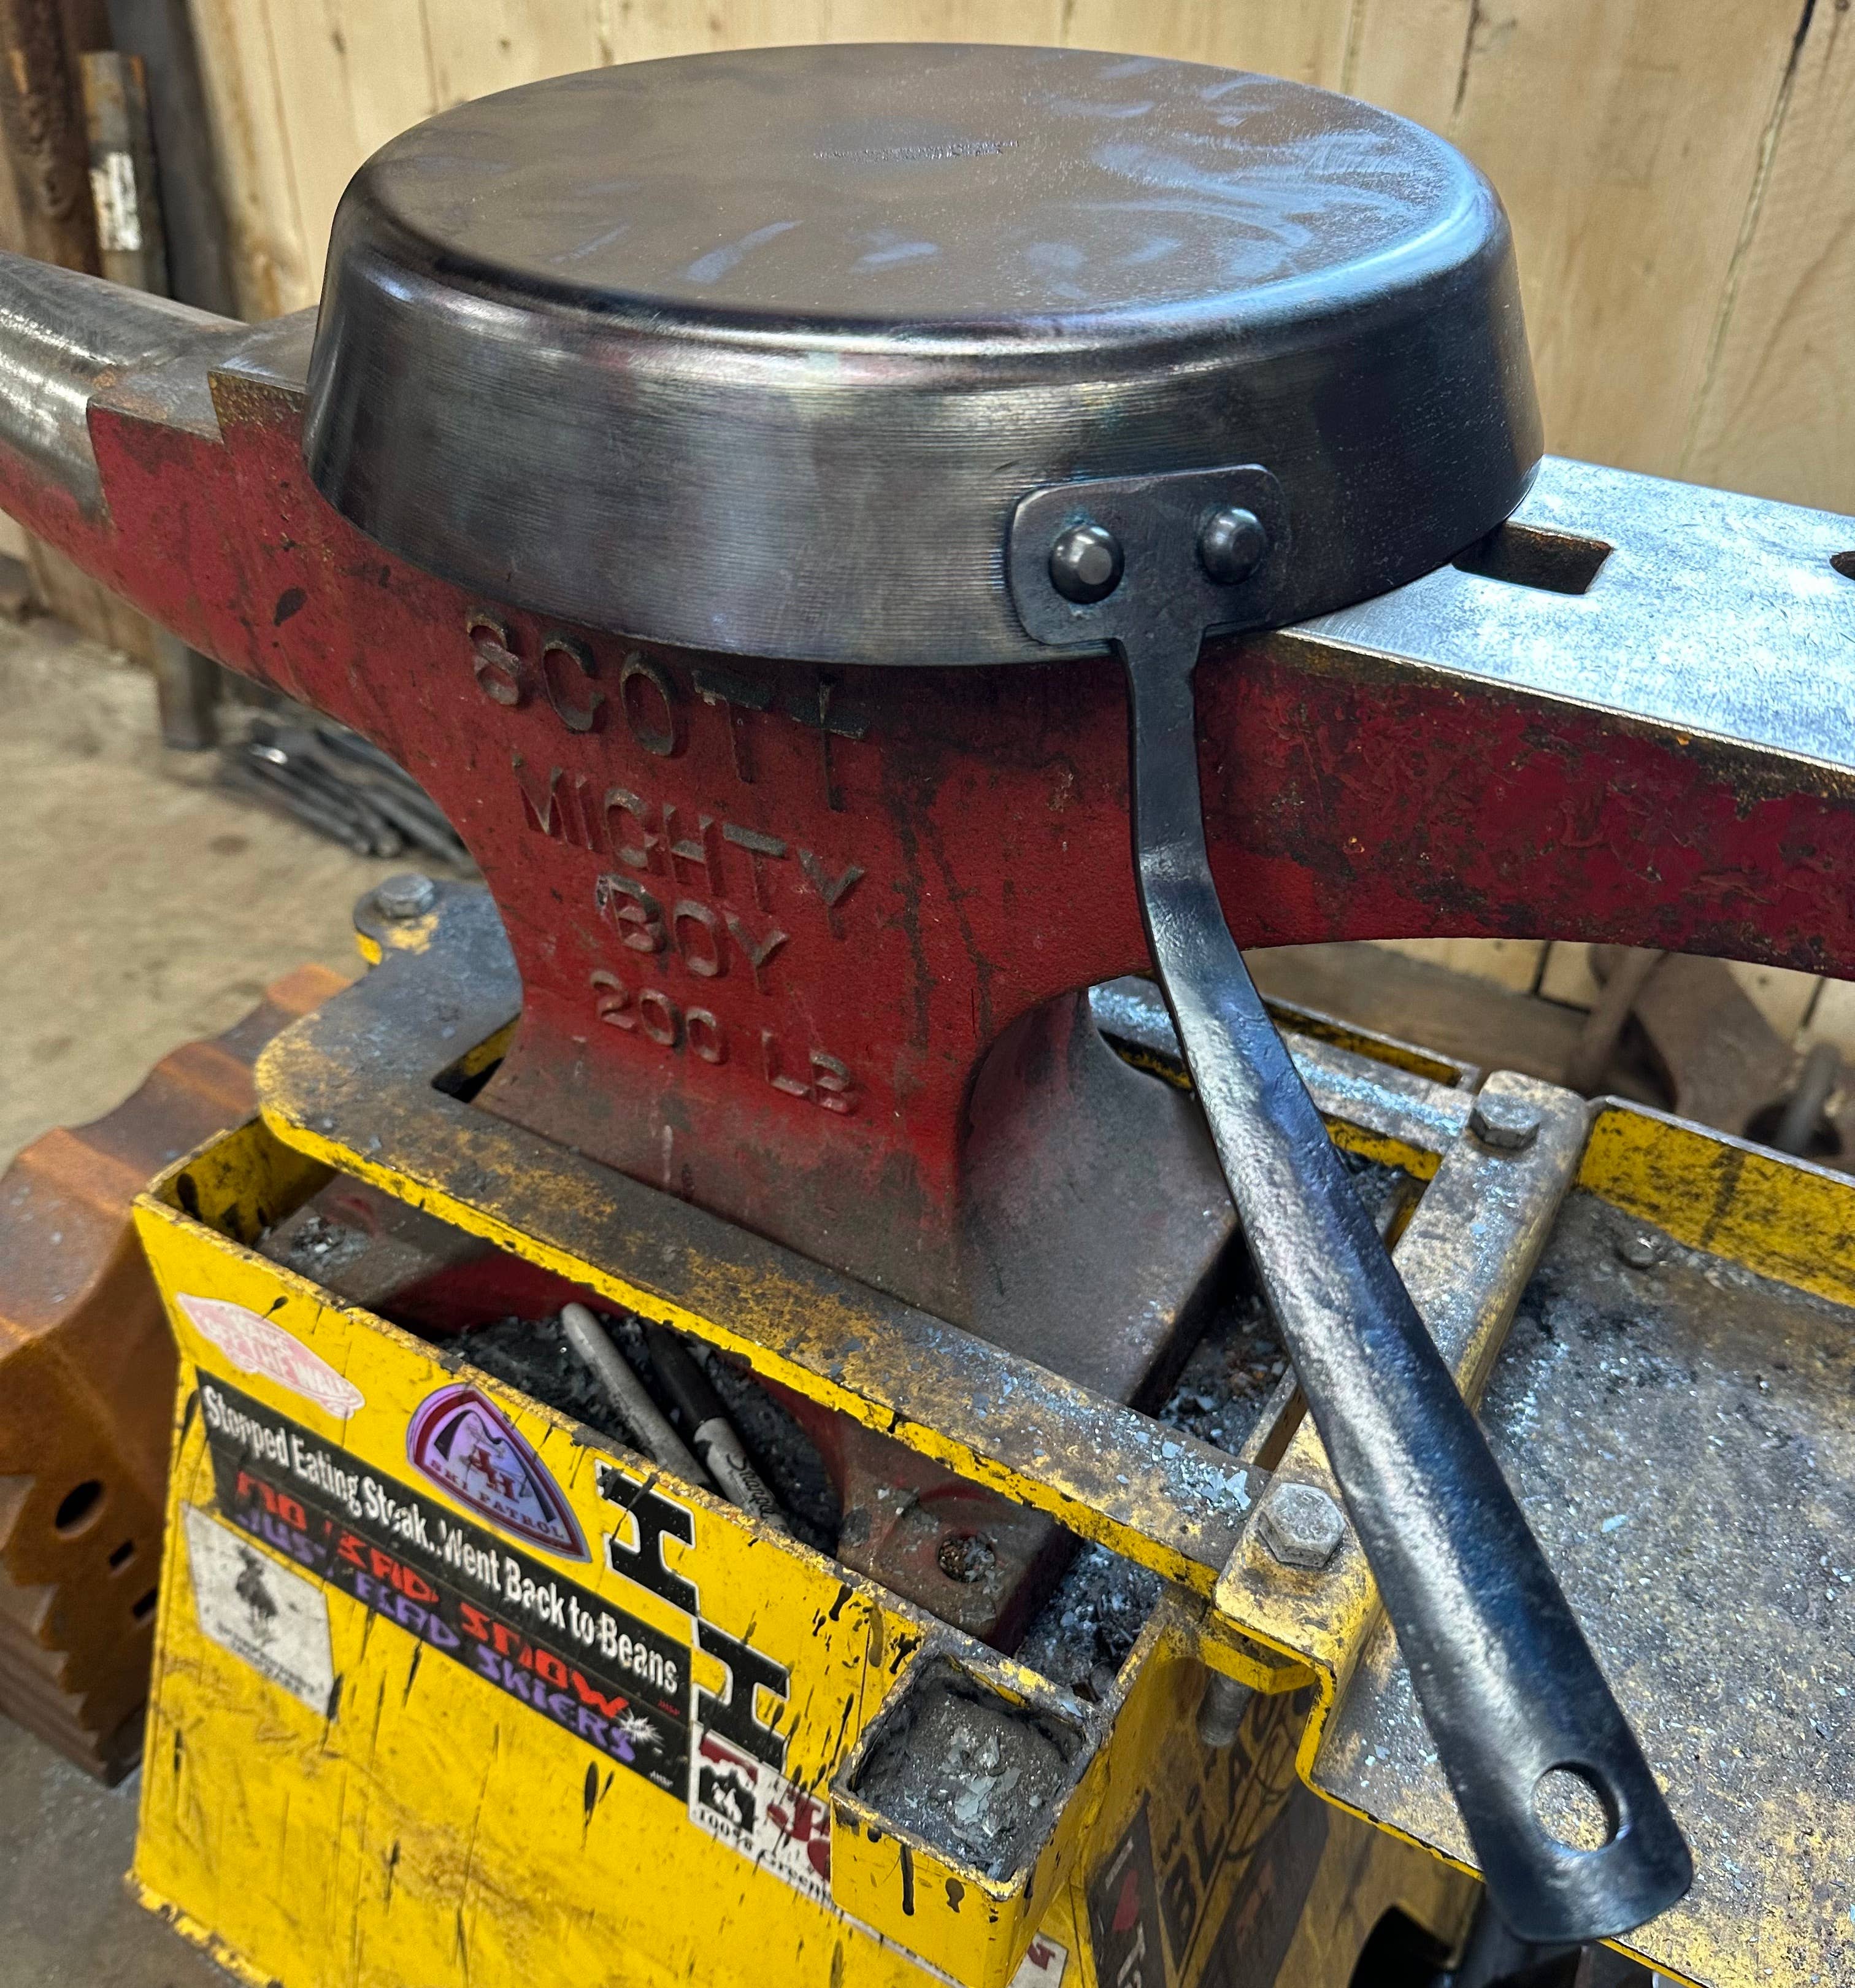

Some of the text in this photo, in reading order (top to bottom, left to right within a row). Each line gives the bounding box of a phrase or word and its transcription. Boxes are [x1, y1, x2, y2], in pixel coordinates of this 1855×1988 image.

[467, 606, 871, 813] SCOTT
[512, 752, 866, 940] MIGHTY
[595, 873, 790, 995] BOY
[590, 968, 856, 1114] 200 LB
[202, 1385, 290, 1467] Stopped
[290, 1433, 360, 1519] Eating
[504, 1556, 566, 1629] Back
[569, 1595, 594, 1647] to
[596, 1611, 678, 1694] Beans
[431, 1458, 566, 1539] SKI PATROL
